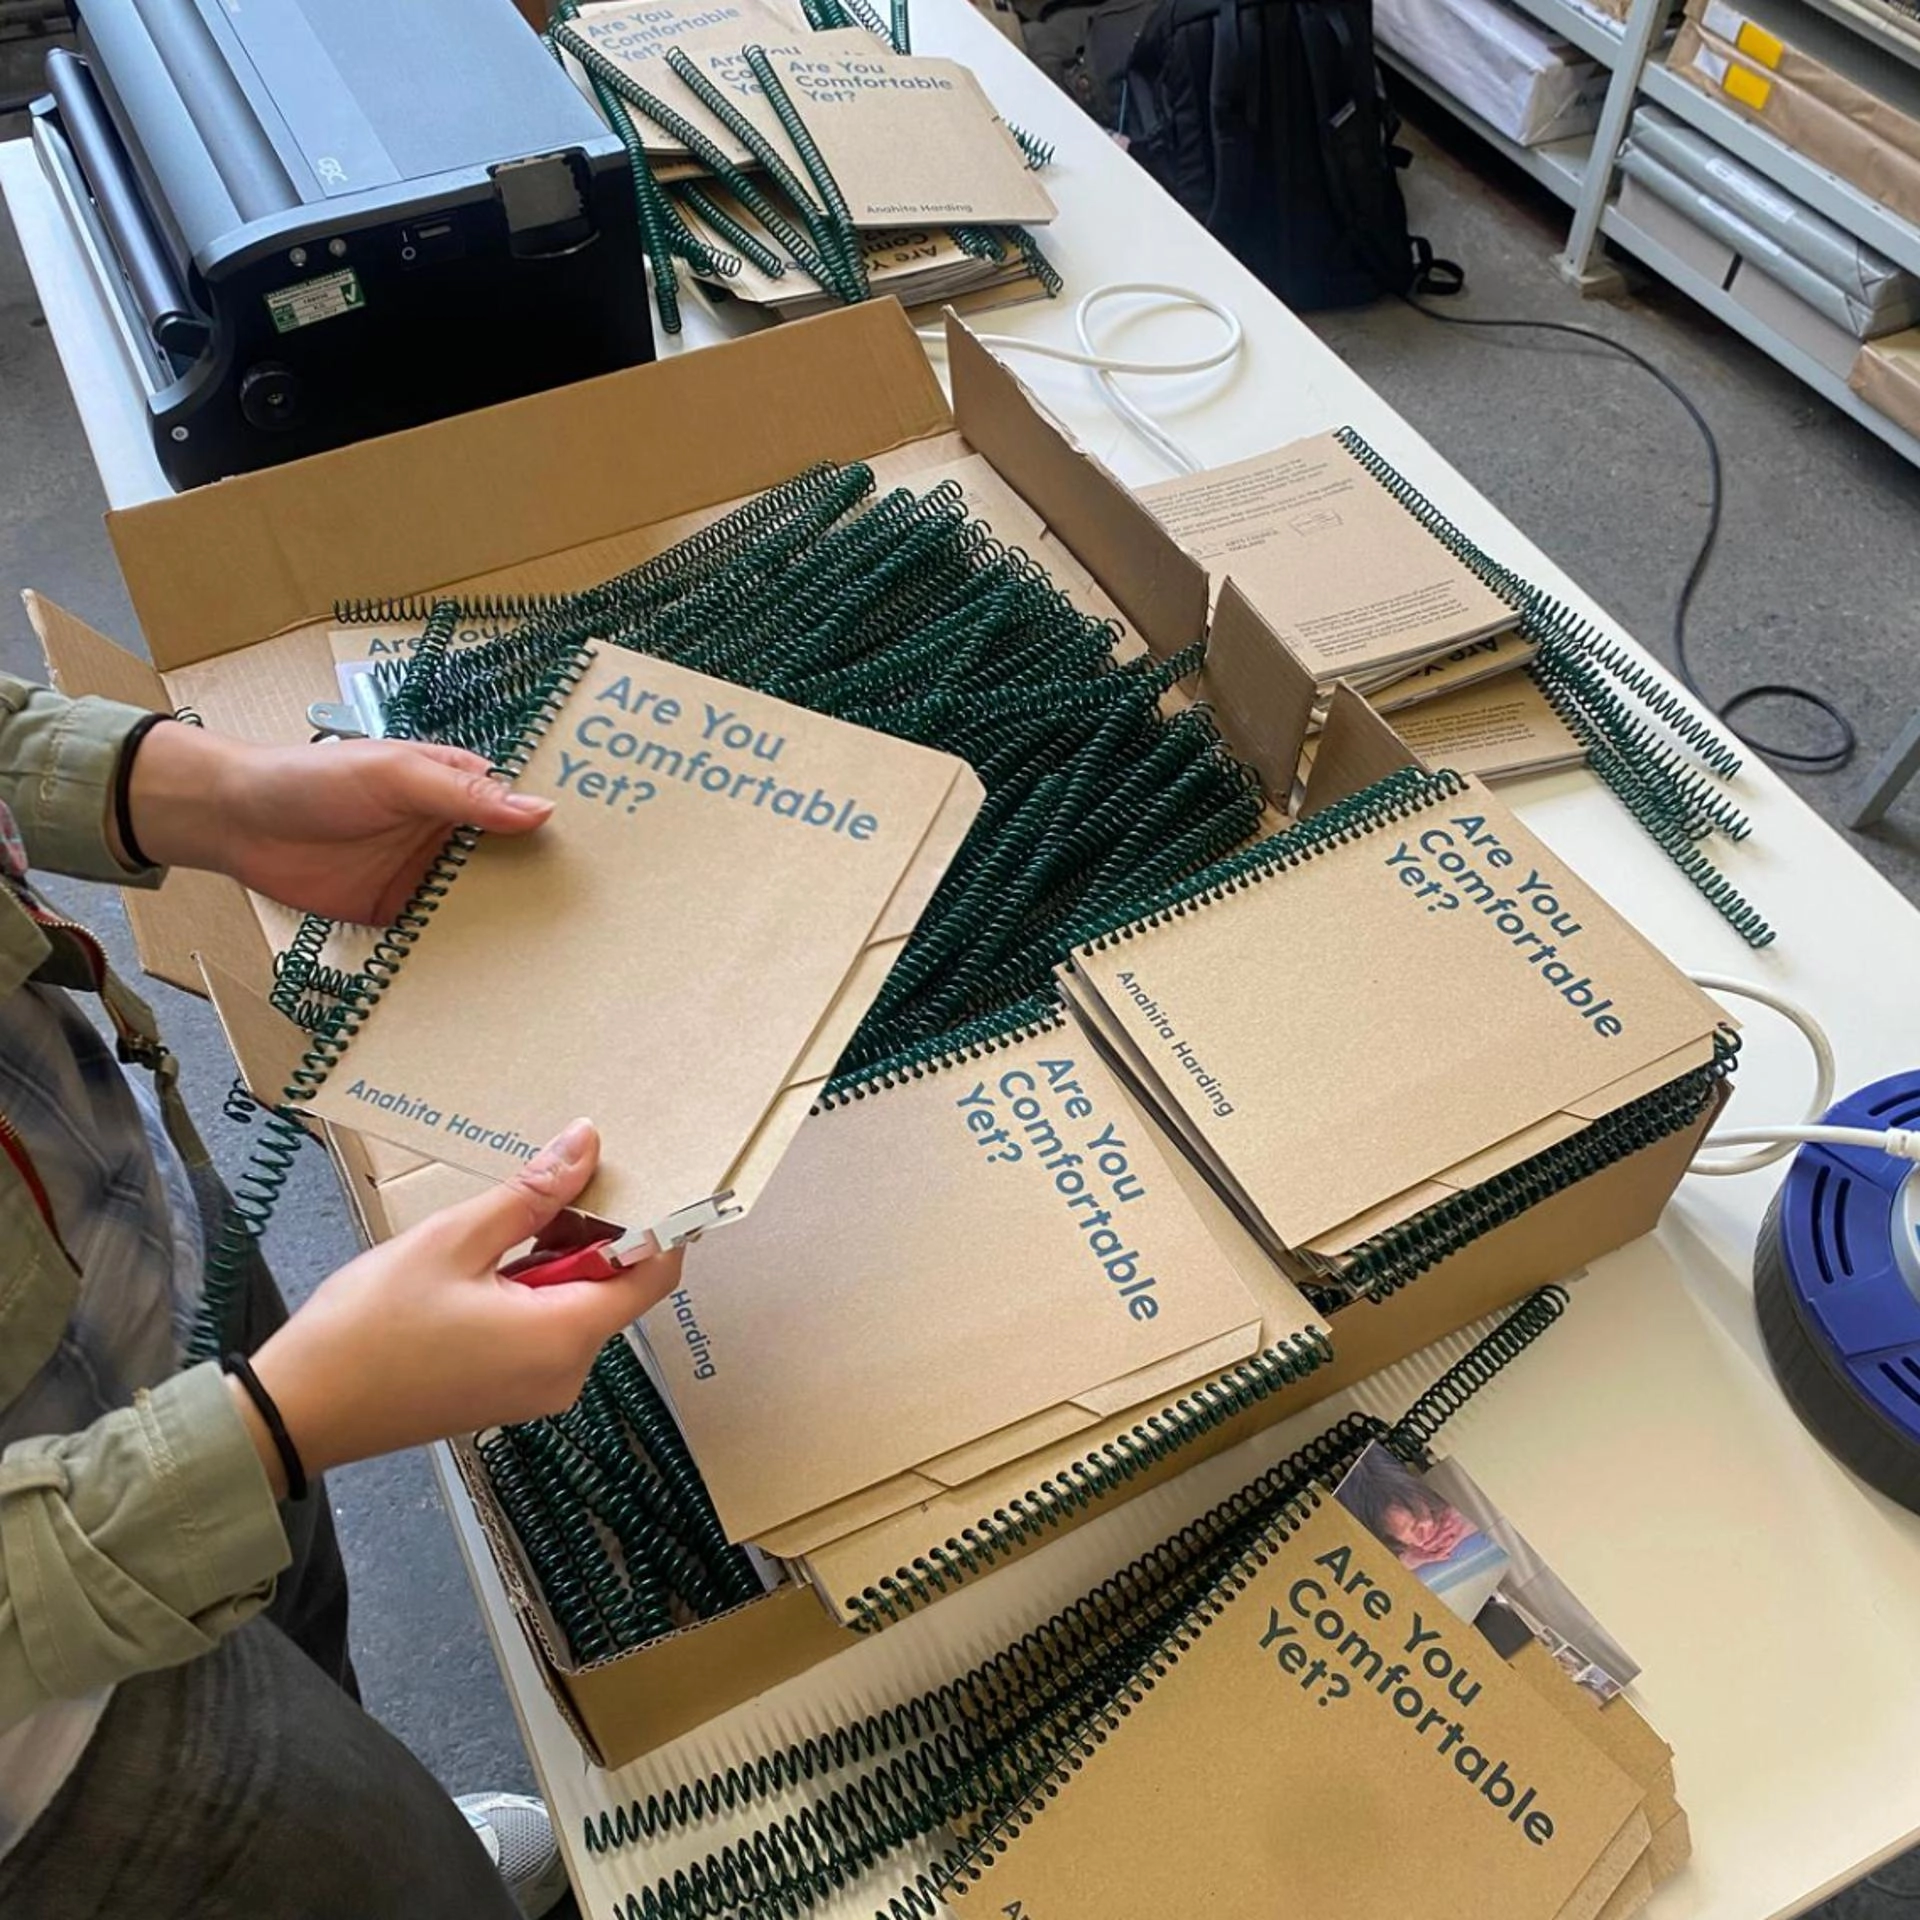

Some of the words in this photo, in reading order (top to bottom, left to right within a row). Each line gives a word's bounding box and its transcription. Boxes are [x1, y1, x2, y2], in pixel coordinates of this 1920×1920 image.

[587, 20, 627, 38] Are
[628, 9, 674, 25] You
[601, 8, 740, 50] Comfortable
[616, 43, 664, 63] Yet?
[789, 60, 831, 74] Are
[836, 61, 885, 74] You
[795, 74, 954, 91] Comfortable
[802, 90, 857, 103] Yet?
[595, 675, 681, 725] Are
[701, 703, 786, 761] You
[556, 751, 657, 814] Yet?
[575, 715, 878, 840] Comfortable
[1384, 842, 1461, 914] Yet?
[1451, 814, 1514, 868] Are
[1516, 870, 1584, 939] You
[1419, 829, 1623, 1039] Comfortable
[1116, 970, 1175, 1041] Anahita
[1171, 1040, 1235, 1118] Harding
[346, 1079, 442, 1126] Anahita
[955, 1082, 1024, 1165] Yet?
[1037, 1058, 1094, 1120] Are
[1086, 1123, 1146, 1203] You
[1000, 1070, 1160, 1322] Comfortable
[670, 1289, 718, 1381] Harding
[1257, 1606, 1352, 1708] Yet?
[1314, 1545, 1393, 1622] Are
[1401, 1612, 1484, 1708] You
[1288, 1577, 1555, 1847] Comfortable
